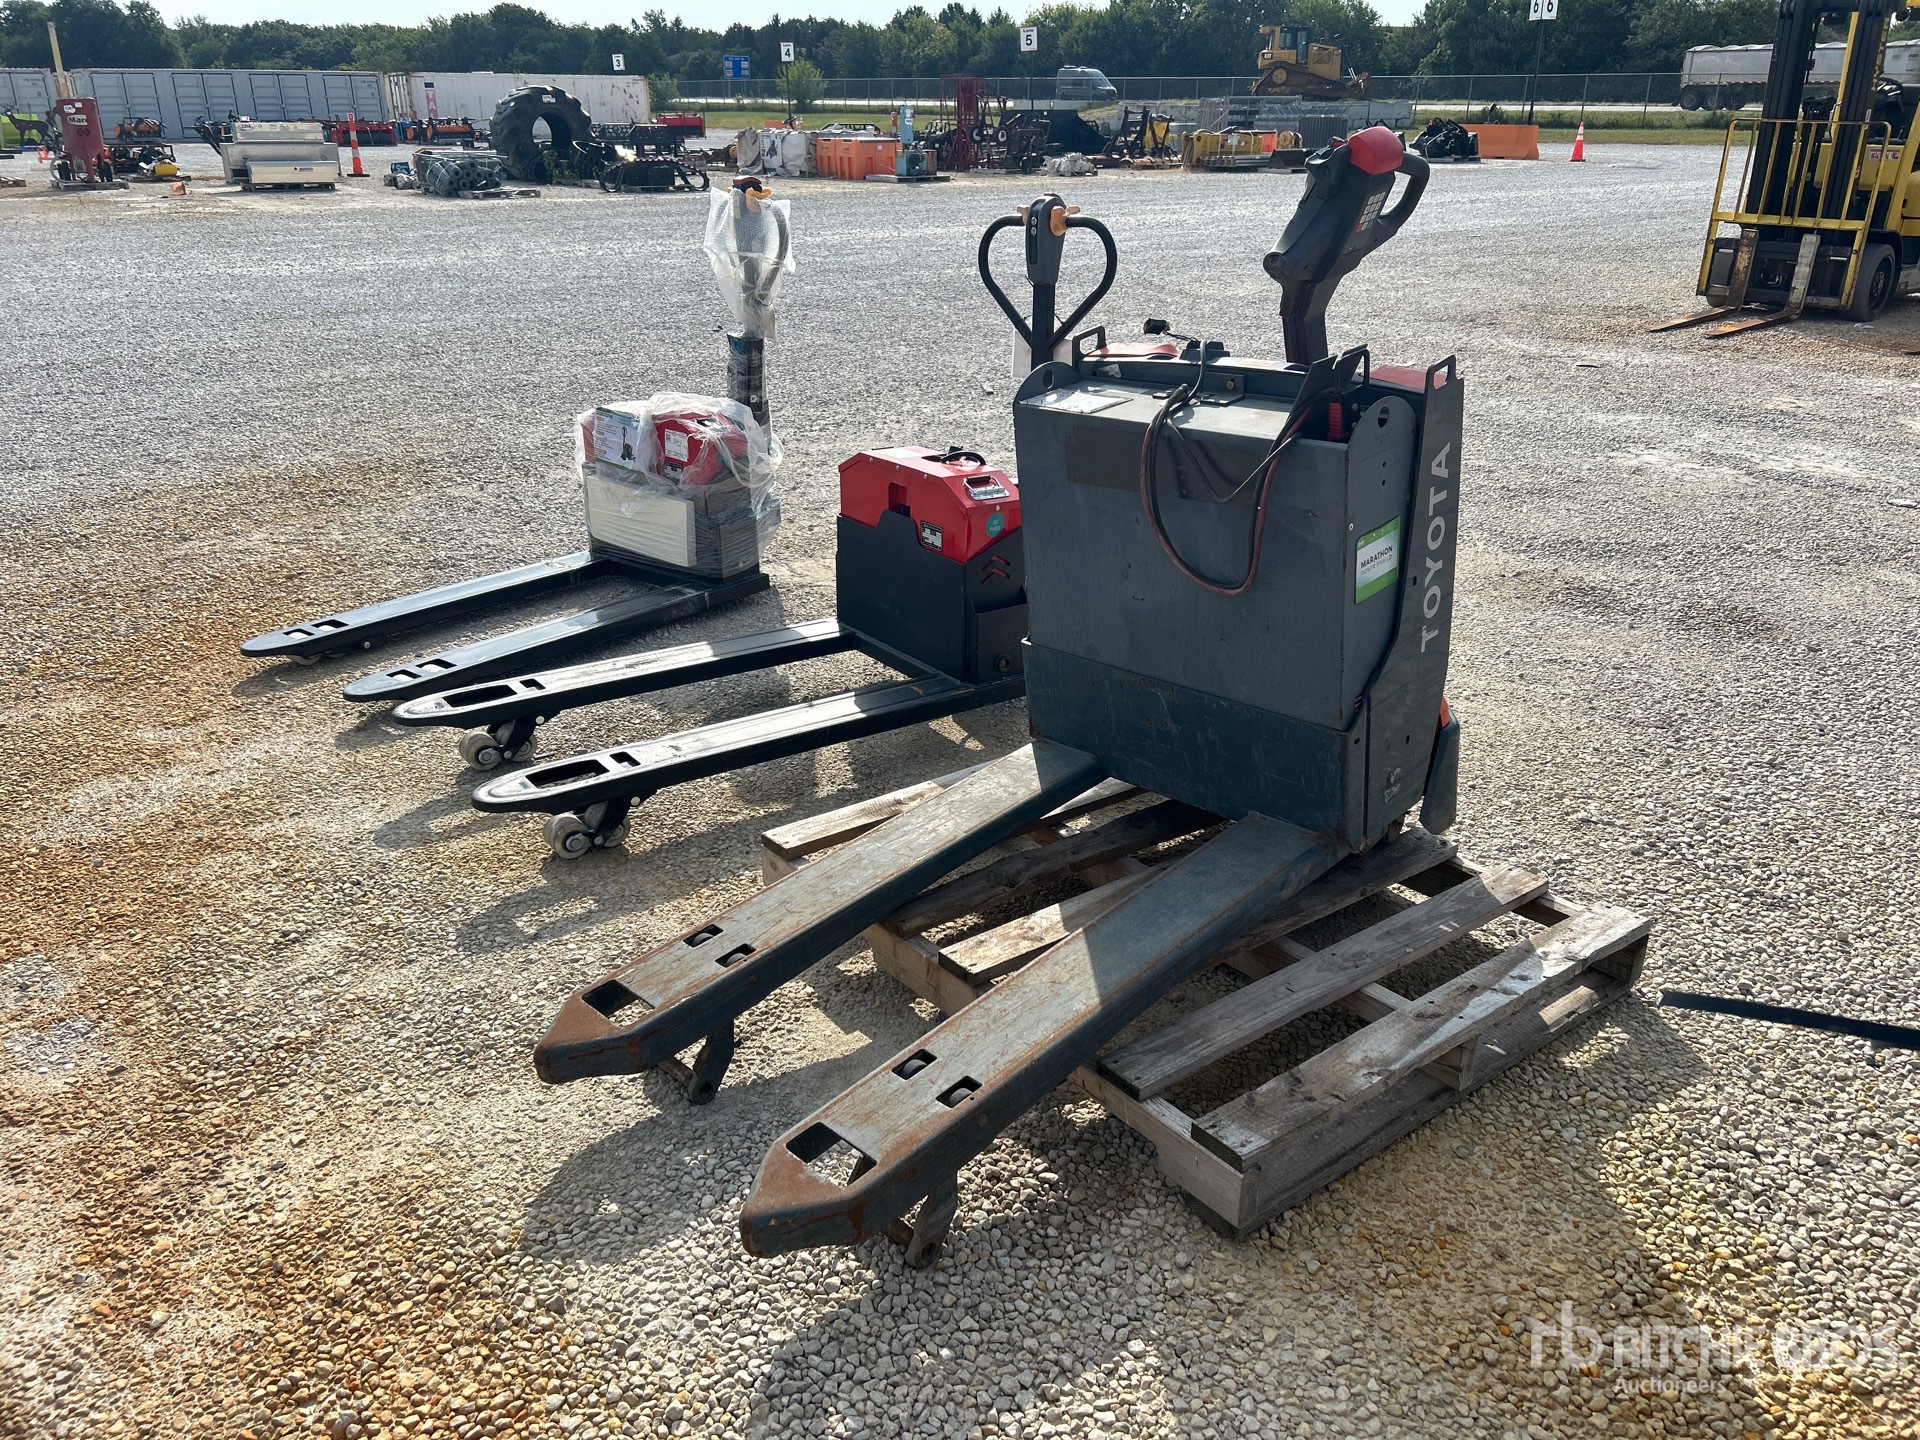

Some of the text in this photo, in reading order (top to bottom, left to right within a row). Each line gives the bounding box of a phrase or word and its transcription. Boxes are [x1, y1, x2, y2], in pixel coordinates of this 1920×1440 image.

[1546, 0, 1553, 13] 6
[1025, 34, 1033, 46] 5
[785, 48, 791, 58] 4
[615, 58, 621, 67] 3
[1421, 441, 1451, 654] TOYOTA
[1360, 544, 1393, 569] MARATHON
